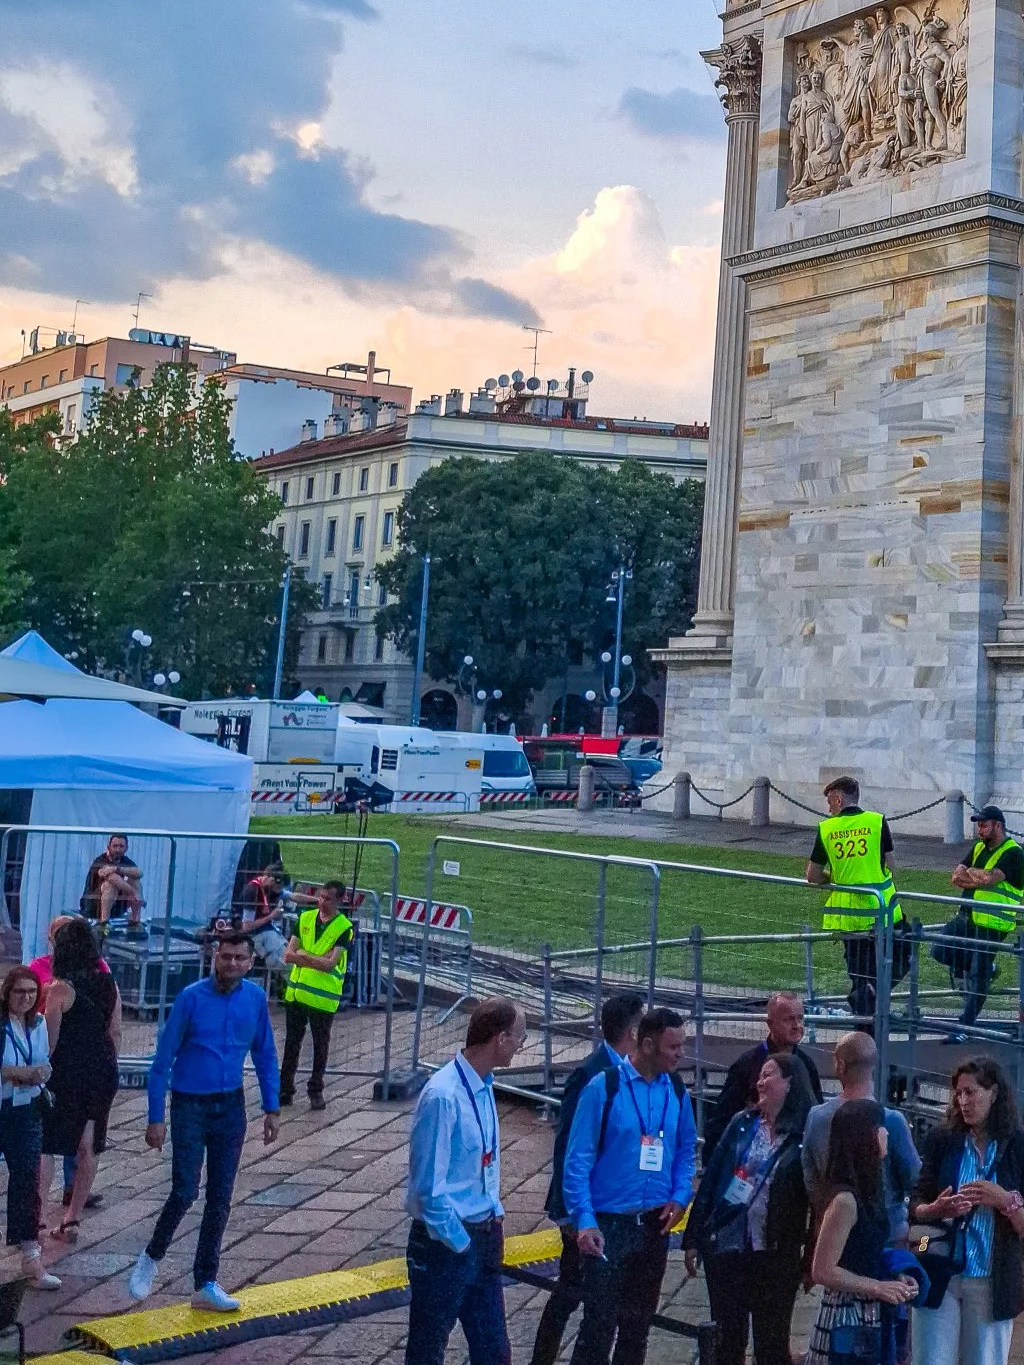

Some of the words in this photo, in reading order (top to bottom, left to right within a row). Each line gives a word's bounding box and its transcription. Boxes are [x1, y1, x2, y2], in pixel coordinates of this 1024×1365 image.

[303, 778, 327, 788] Power
[830, 828, 872, 840] ASSISTENZA
[835, 838, 868, 860] 323
